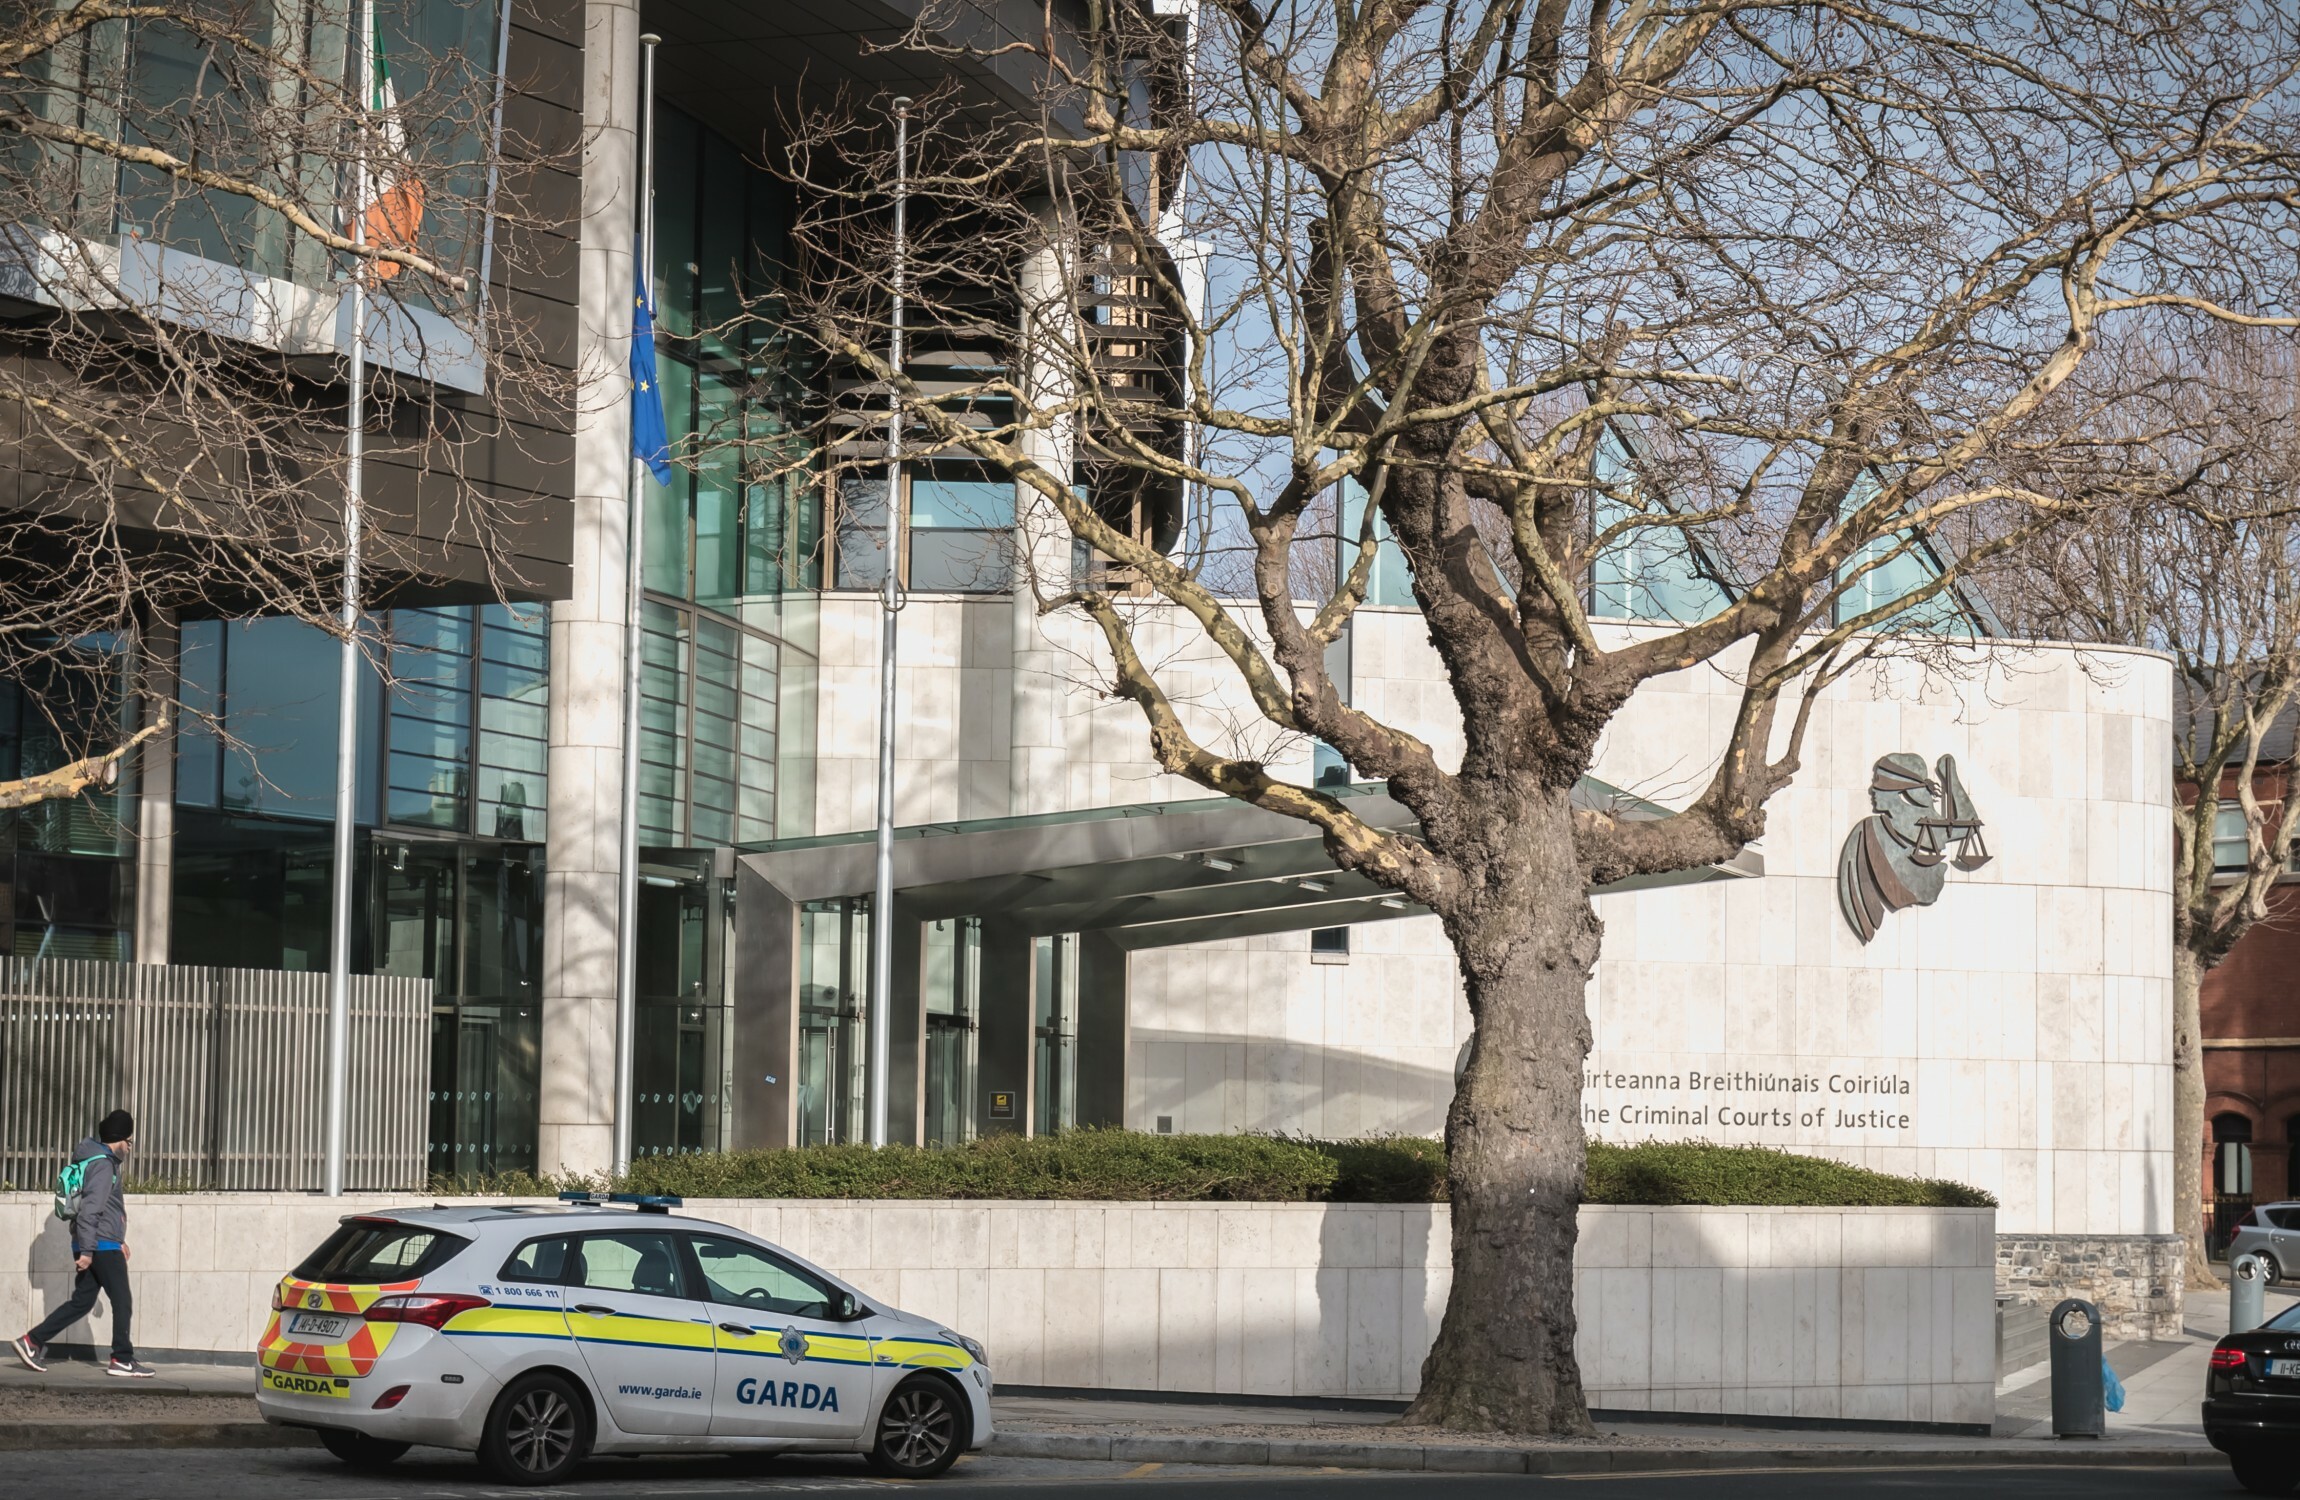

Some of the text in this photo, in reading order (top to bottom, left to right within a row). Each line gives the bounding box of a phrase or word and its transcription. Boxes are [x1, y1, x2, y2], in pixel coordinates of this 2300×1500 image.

[1586, 1069, 1910, 1095] irteanna Breithiúnais Coiriúla
[1584, 1103, 1910, 1129] he Criminal Courts of Justice
[495, 1287, 559, 1298] 1 800 666 111
[298, 1318, 339, 1333] 141-D-4907
[273, 1375, 332, 1394] GARDA
[618, 1383, 702, 1400] www.garda.ie
[736, 1377, 839, 1413] GARDA
